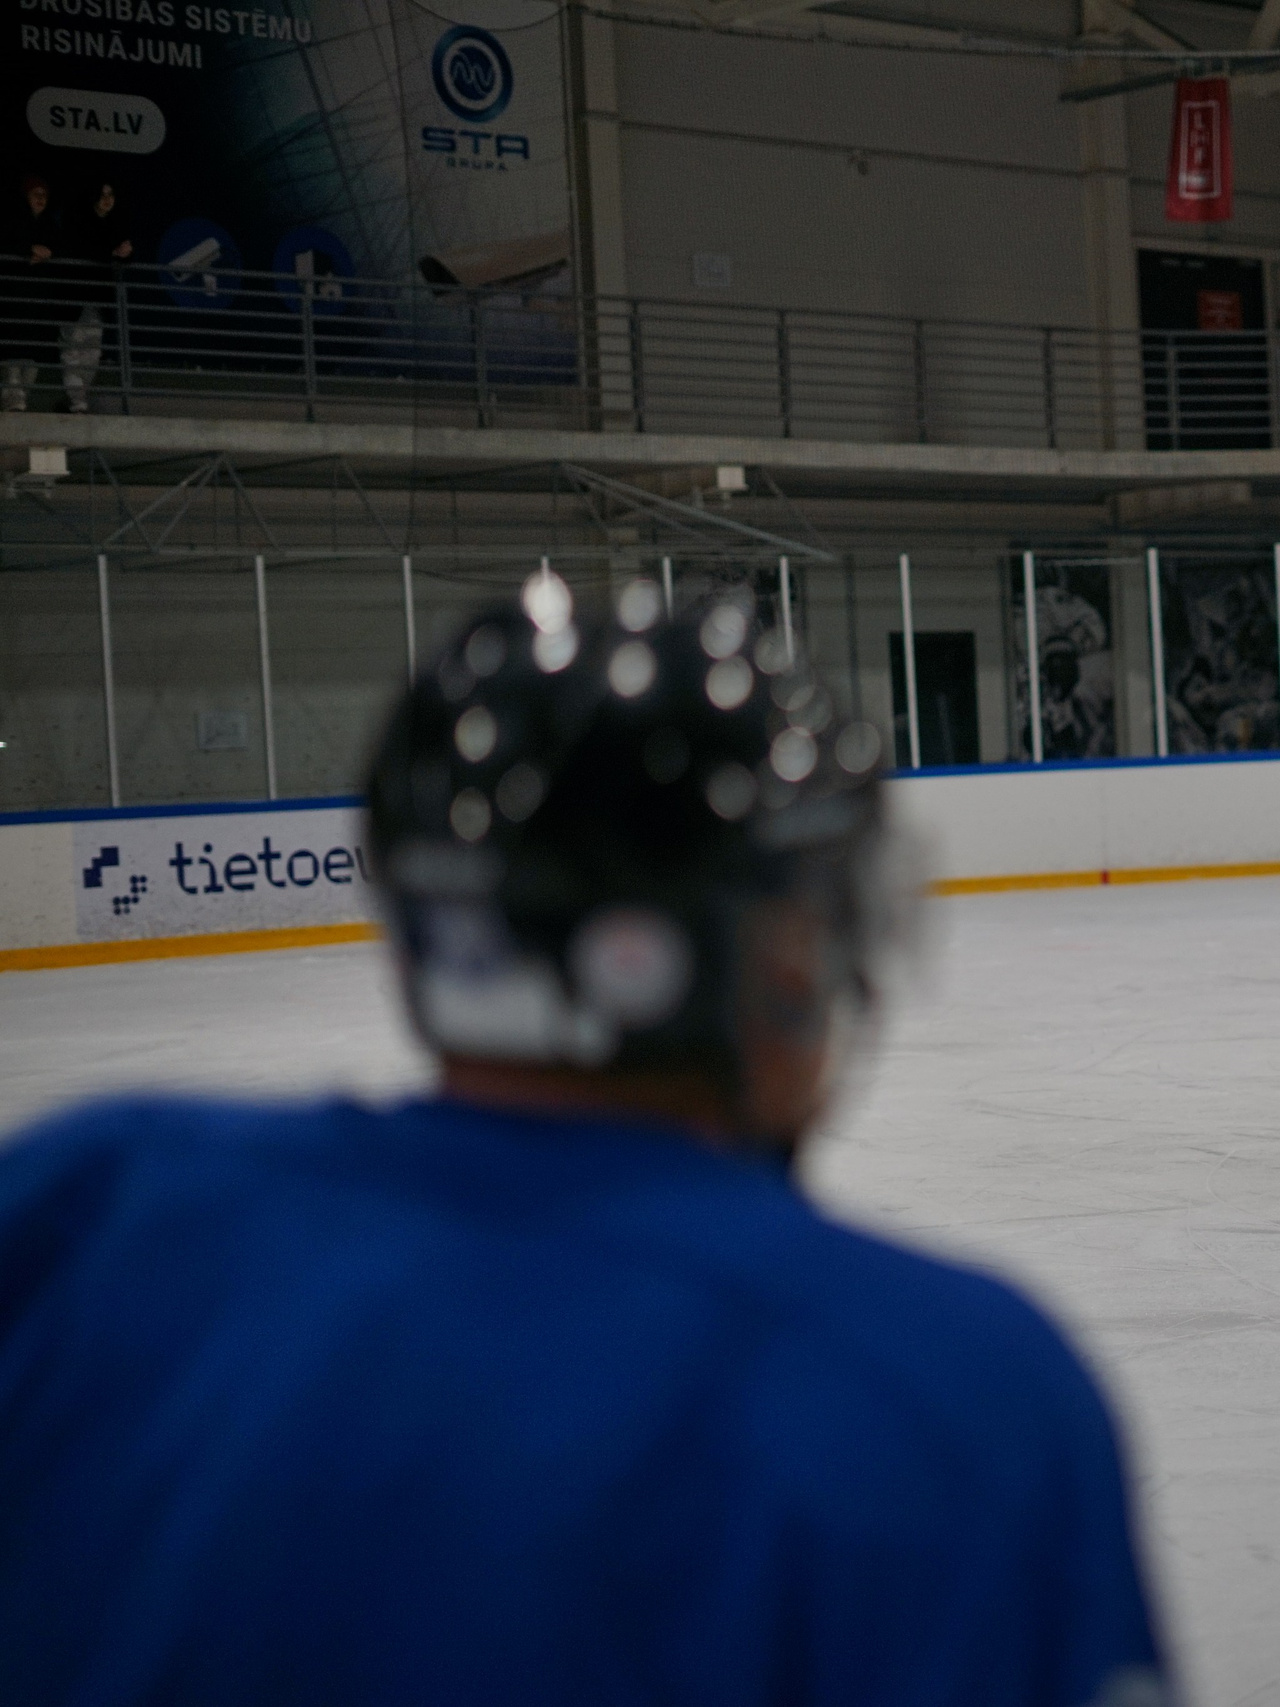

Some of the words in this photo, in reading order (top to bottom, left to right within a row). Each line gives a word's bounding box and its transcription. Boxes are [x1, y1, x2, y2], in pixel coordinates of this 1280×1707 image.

[184, 4, 313, 44] SISTĒMU
[20, 23, 203, 70] RISINĀJUMI
[50, 105, 143, 136] STA.LV
[422, 126, 529, 160] STA
